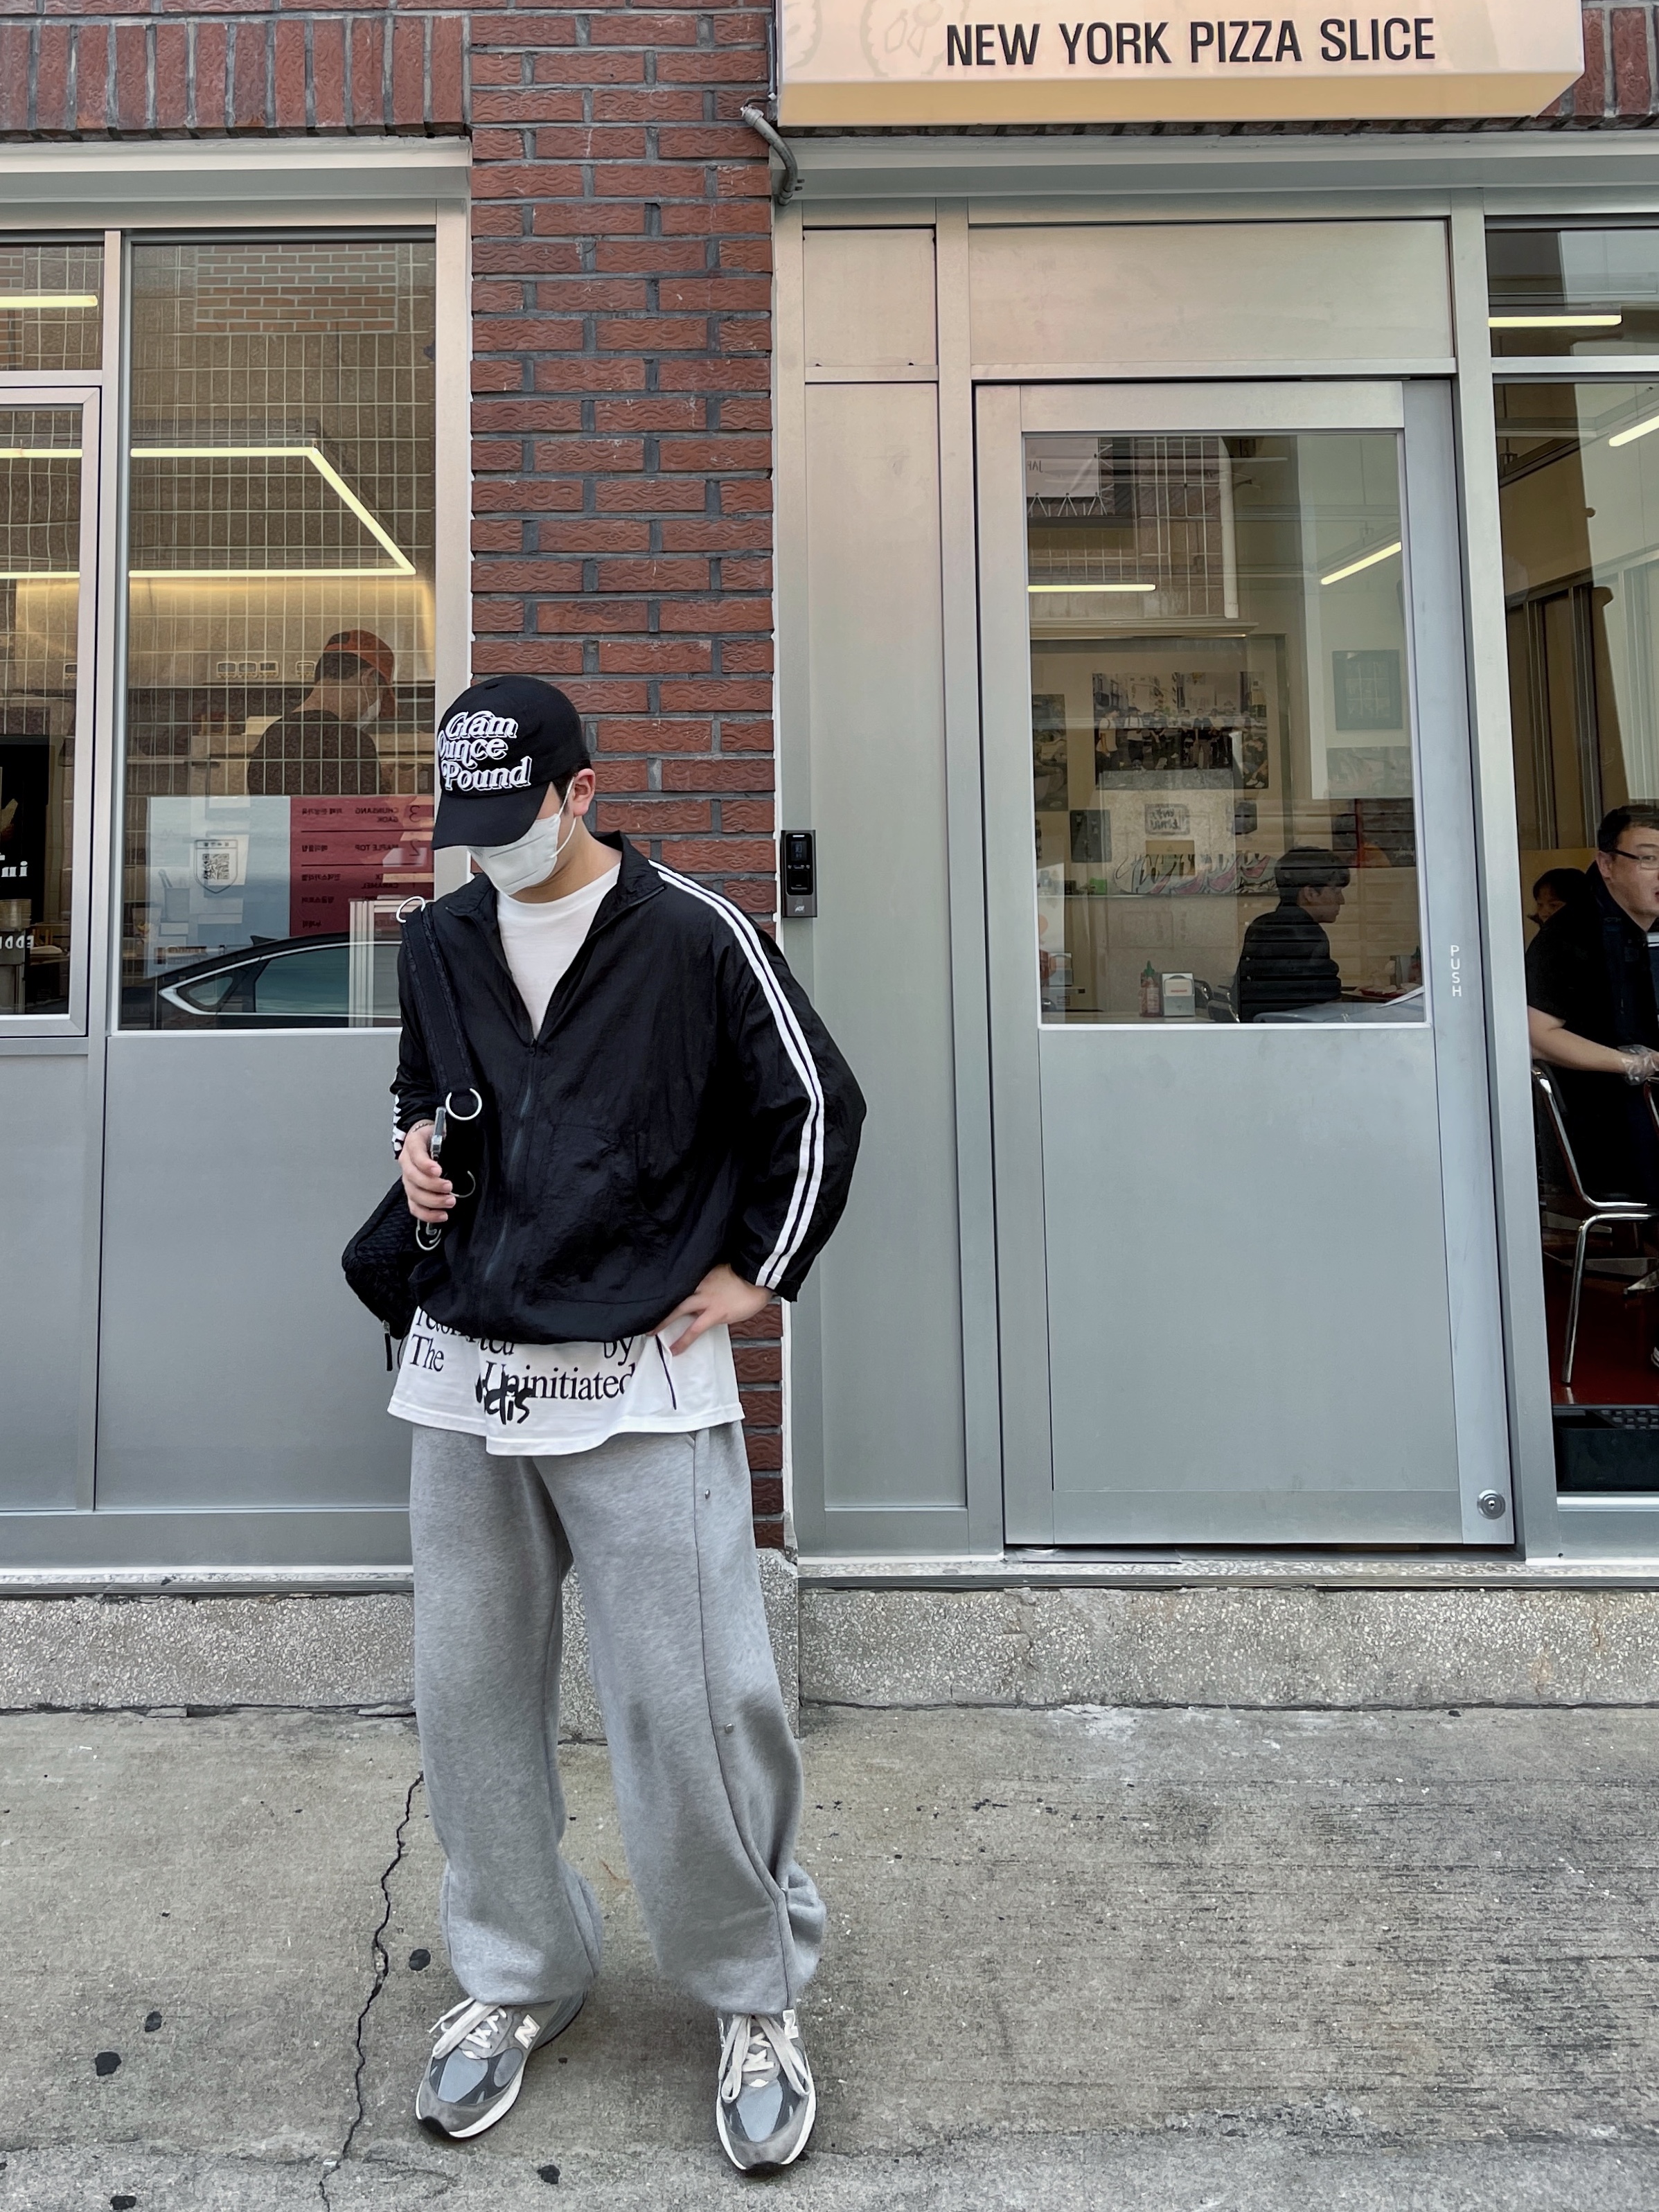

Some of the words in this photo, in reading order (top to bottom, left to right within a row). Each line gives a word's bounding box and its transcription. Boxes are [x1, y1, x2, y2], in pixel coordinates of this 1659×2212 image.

[947, 24, 1040, 66] NEW
[1058, 21, 1172, 64] YORK
[1191, 20, 1302, 63] PIZZA
[1320, 17, 1435, 62] SLICE
[441, 756, 532, 791] Pound
[1450, 944, 1462, 997] PUSH
[409, 1333, 445, 1372] The
[514, 2014, 540, 2049] N
